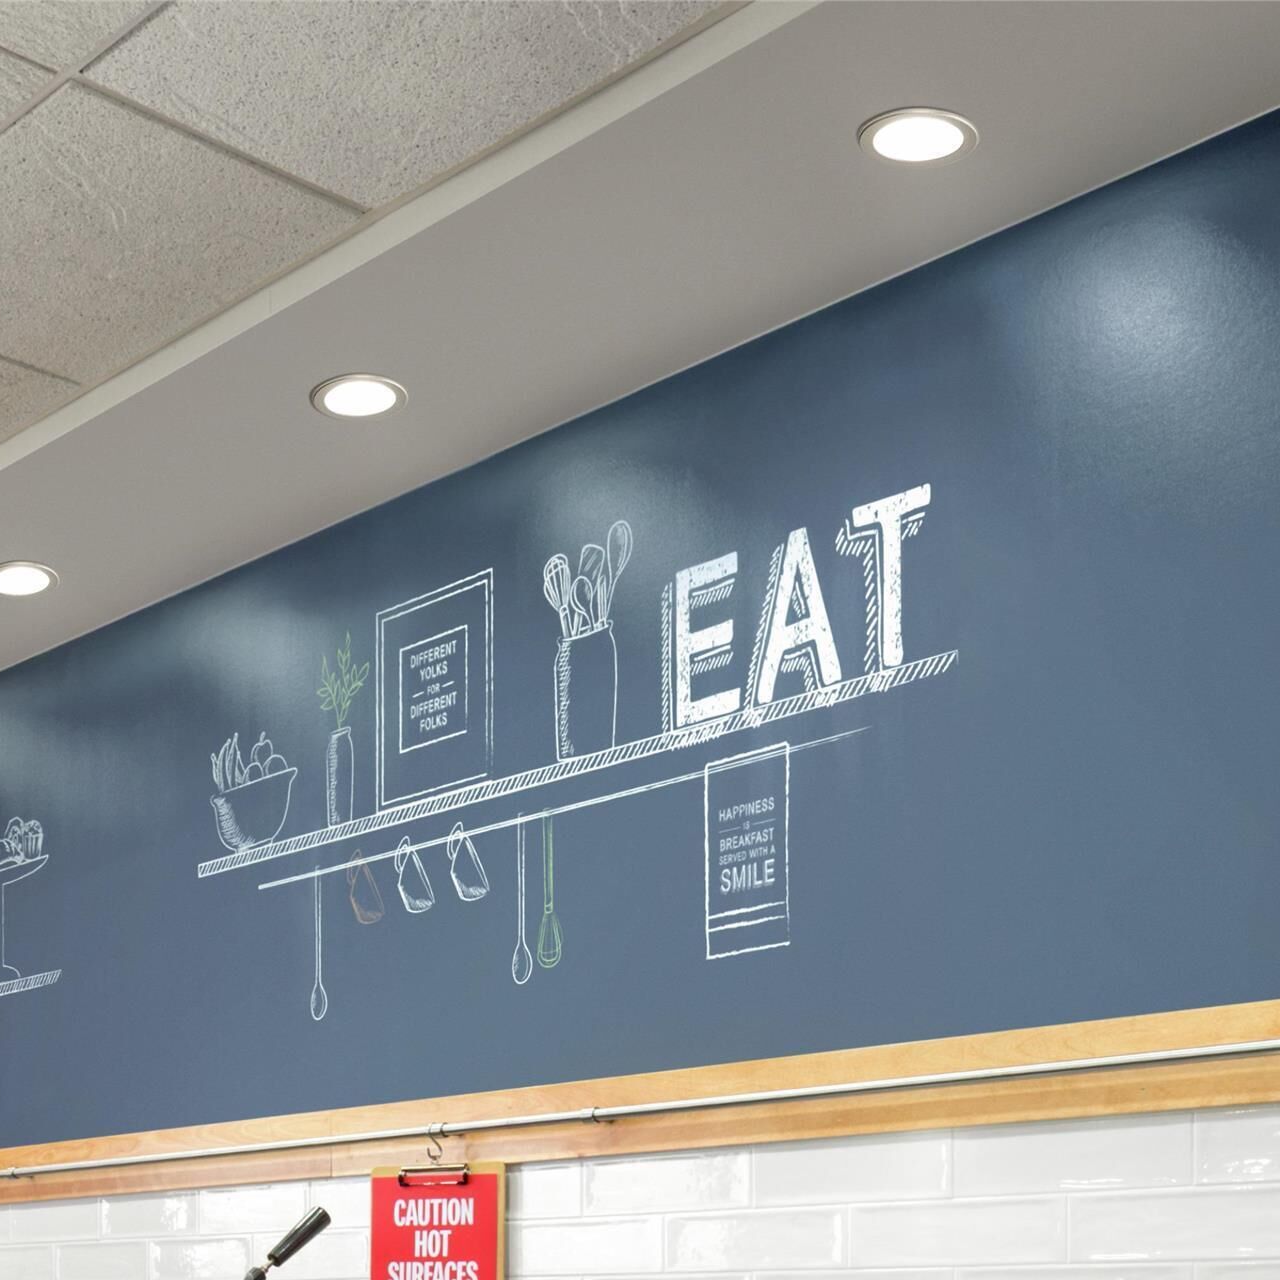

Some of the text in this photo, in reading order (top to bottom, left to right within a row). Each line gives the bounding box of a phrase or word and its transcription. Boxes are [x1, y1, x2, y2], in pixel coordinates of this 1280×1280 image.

[663, 483, 931, 731] EAT
[410, 640, 457, 668] DIFFERENT
[420, 661, 447, 681] YOLKS
[427, 683, 440, 695] FOR
[410, 692, 457, 719] DIFFERENT
[420, 713, 447, 732] FOLKS
[719, 797, 774, 822] HAPPINESS
[720, 827, 774, 852] BREAKFAST
[719, 844, 776, 865] SERVED WITH A
[721, 858, 775, 891] SMILE
[394, 1198, 474, 1227] CAUTION
[414, 1230, 451, 1257] HOT
